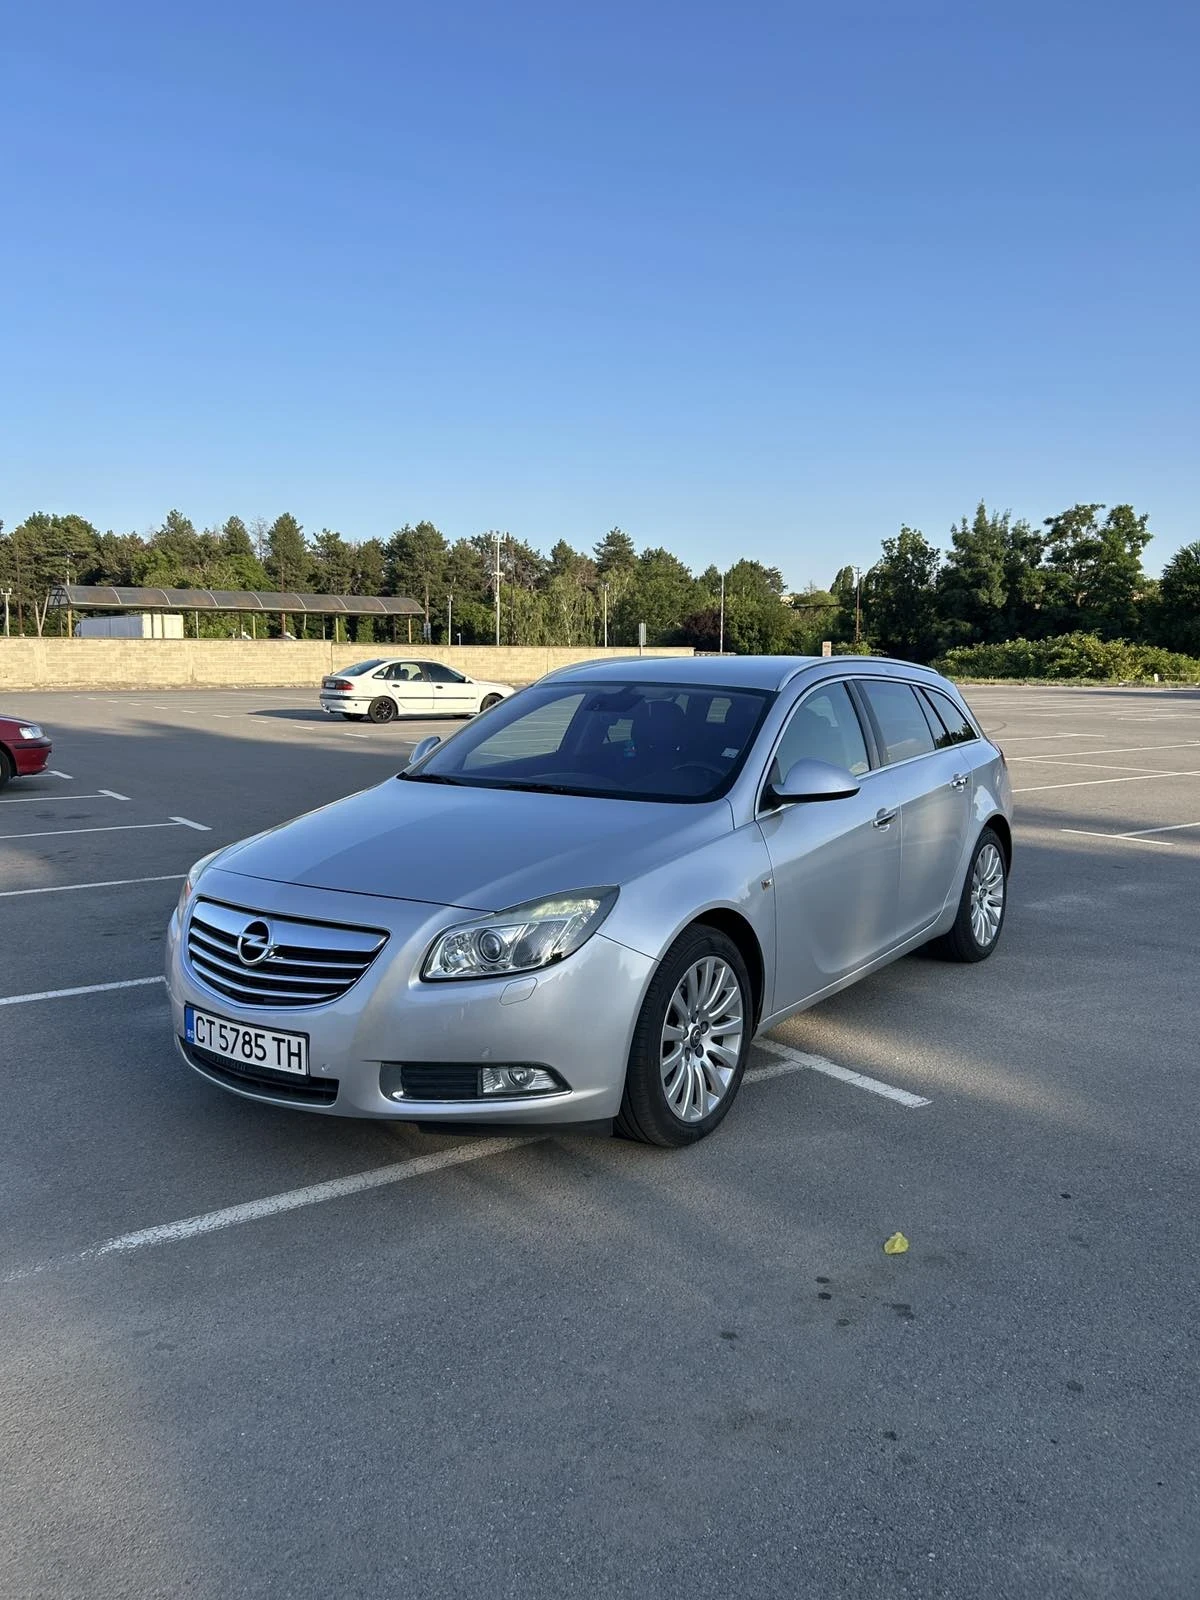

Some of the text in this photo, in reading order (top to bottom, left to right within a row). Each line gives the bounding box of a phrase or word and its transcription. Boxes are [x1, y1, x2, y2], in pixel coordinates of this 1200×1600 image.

[196, 1016, 215, 1047] CT
[219, 1024, 267, 1062] 5785
[272, 1036, 302, 1070] TH
